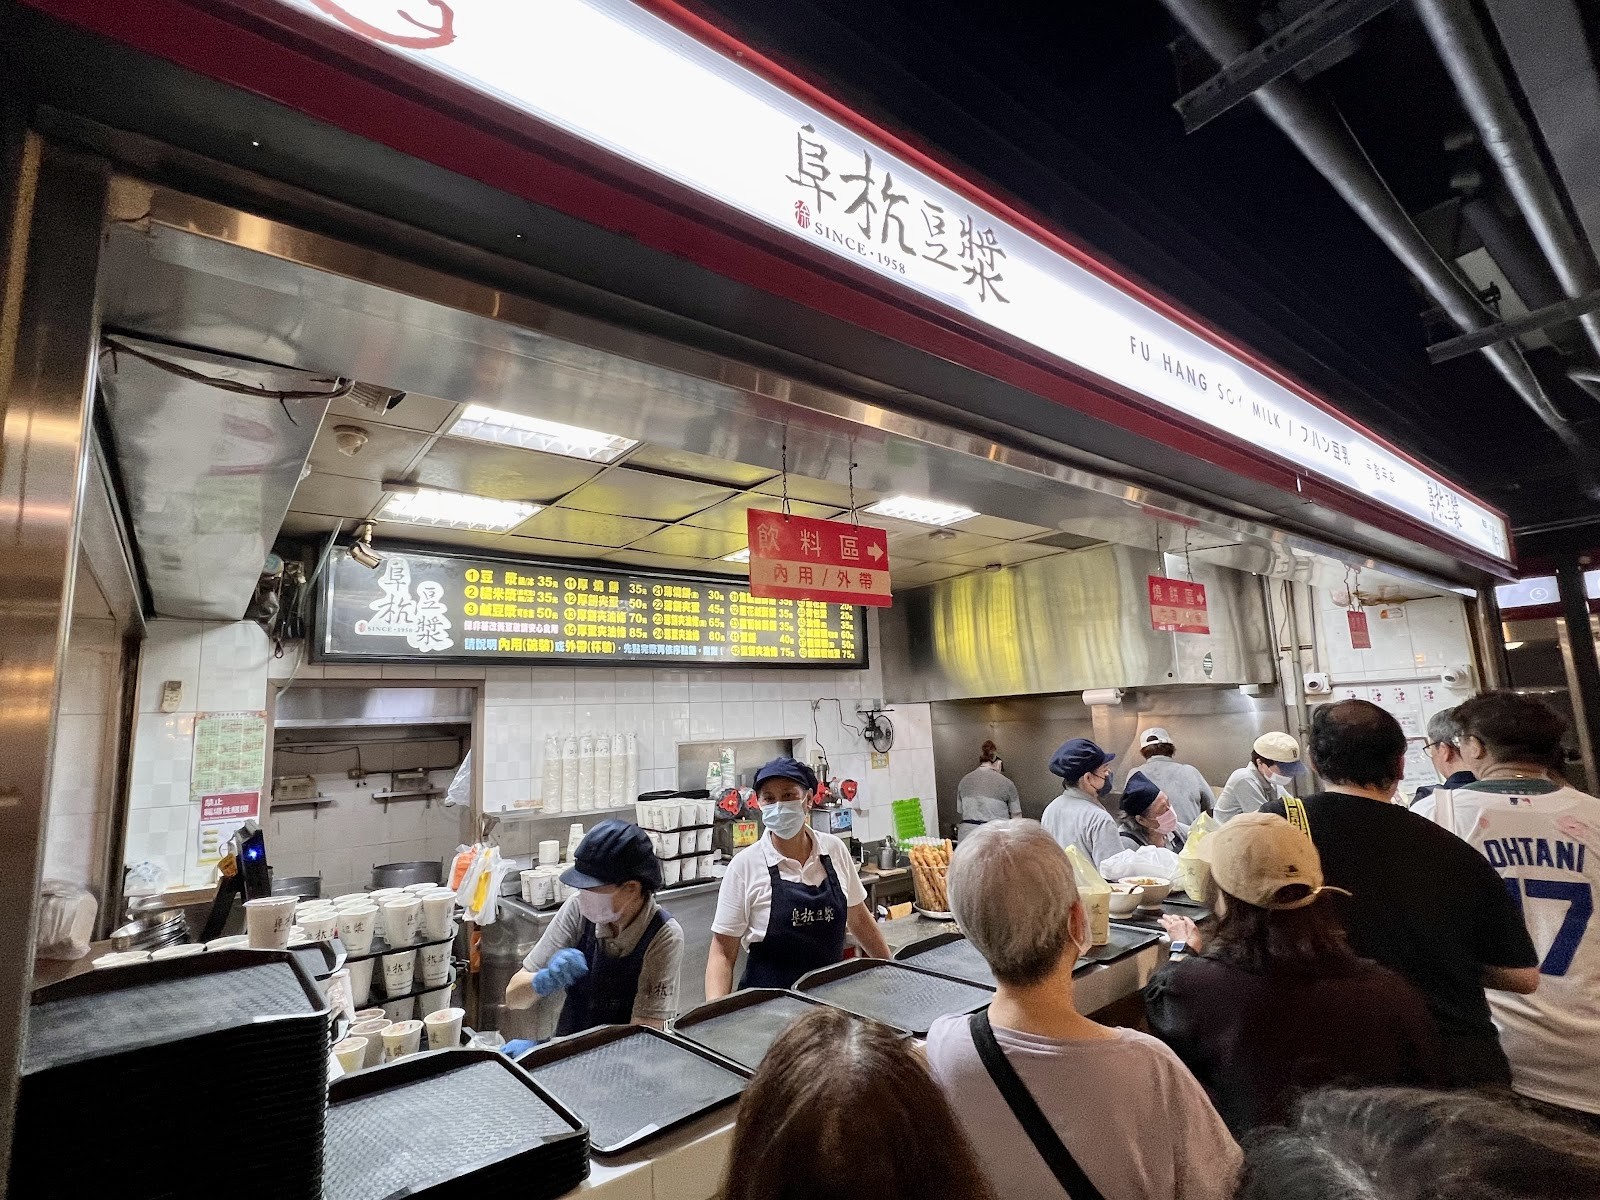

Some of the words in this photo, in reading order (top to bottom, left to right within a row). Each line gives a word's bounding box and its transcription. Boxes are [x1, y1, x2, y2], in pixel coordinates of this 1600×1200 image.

[785, 123, 1010, 304] 阜杭豆漿
[1130, 335, 1151, 362] FU
[1162, 352, 1208, 392] HANG
[1252, 401, 1281, 430] MILK
[756, 523, 860, 561] 飲料區
[1484, 837, 1586, 873] OHTANI
